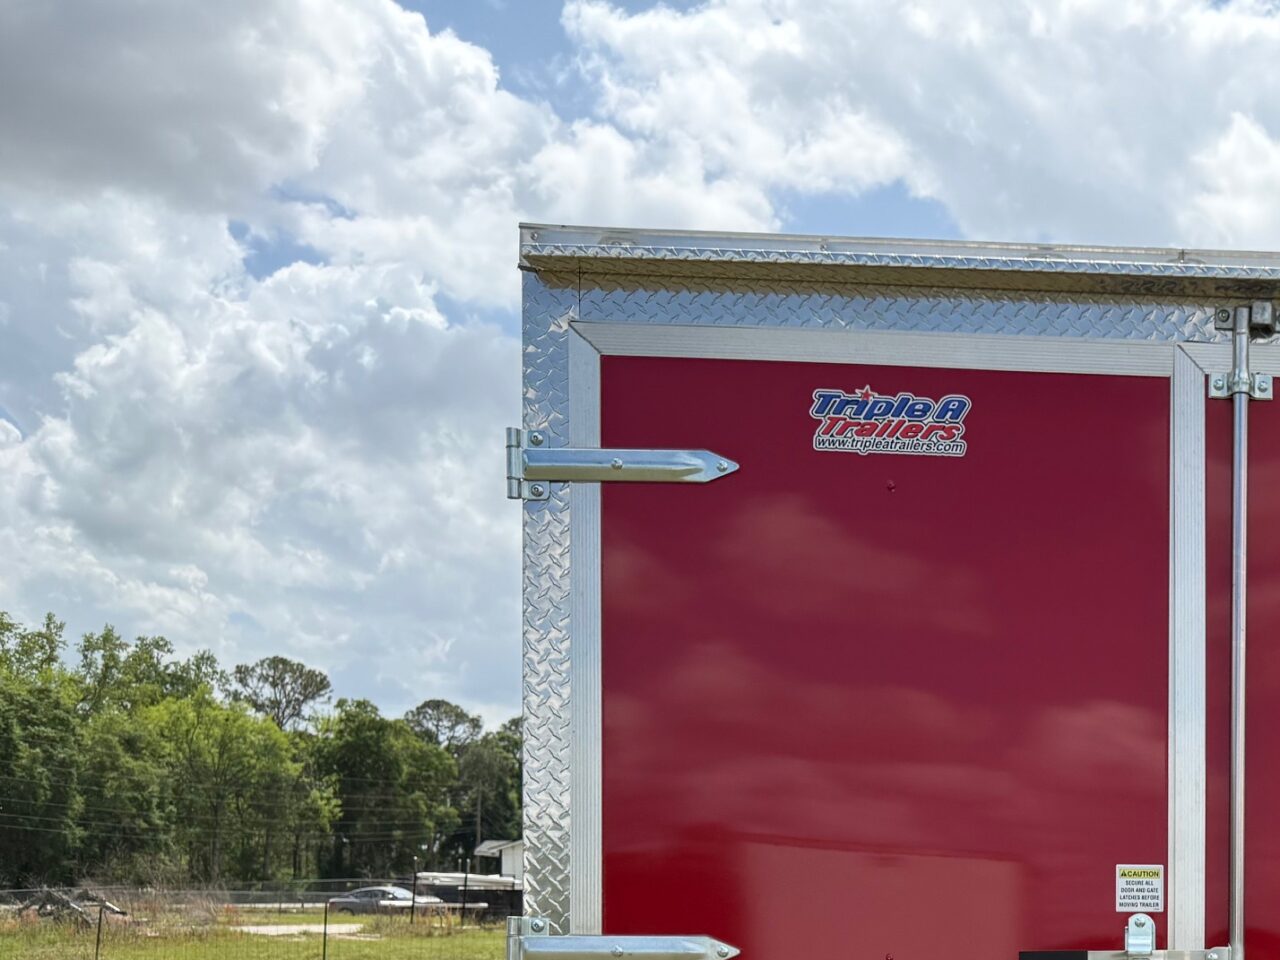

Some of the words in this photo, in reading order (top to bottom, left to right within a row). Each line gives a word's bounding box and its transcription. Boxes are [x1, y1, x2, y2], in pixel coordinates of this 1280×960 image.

[812, 391, 934, 421] Triple
[932, 397, 970, 421] A
[819, 416, 962, 441] Trailers
[817, 437, 964, 453] www.tripleatrailers.com
[1127, 870, 1159, 878] CAUTION
